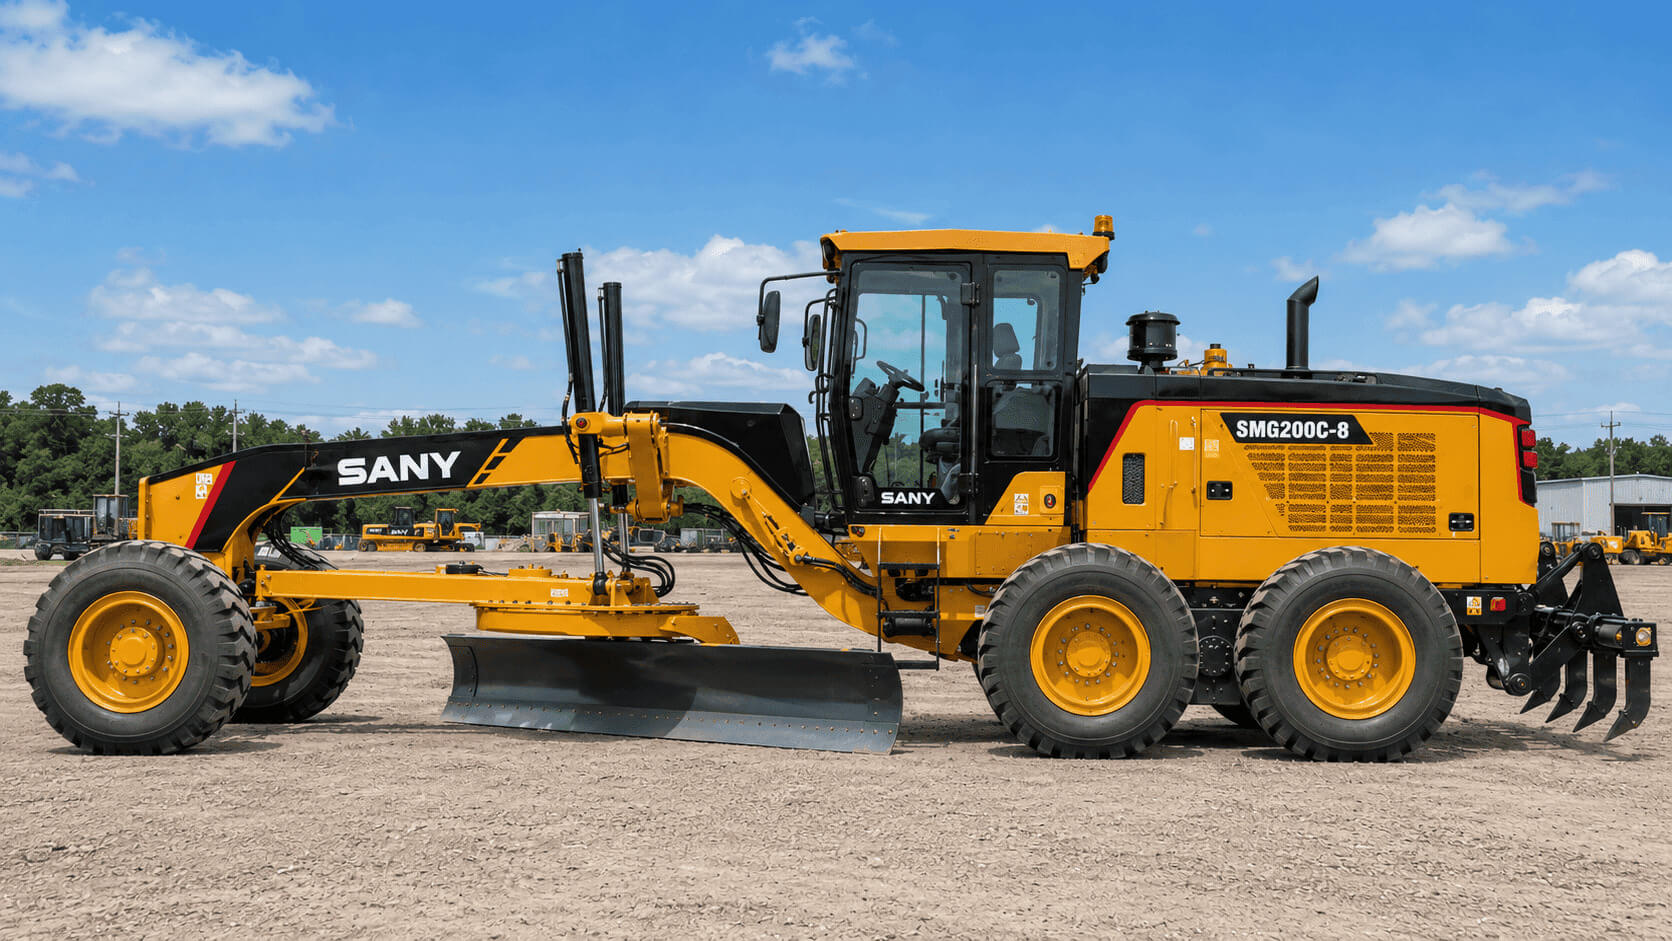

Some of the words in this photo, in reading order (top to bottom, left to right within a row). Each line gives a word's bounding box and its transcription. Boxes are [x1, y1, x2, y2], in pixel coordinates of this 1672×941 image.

[1236, 420, 1349, 438] SMG200C-8
[337, 451, 460, 485] SANY
[881, 492, 936, 505] SANY
